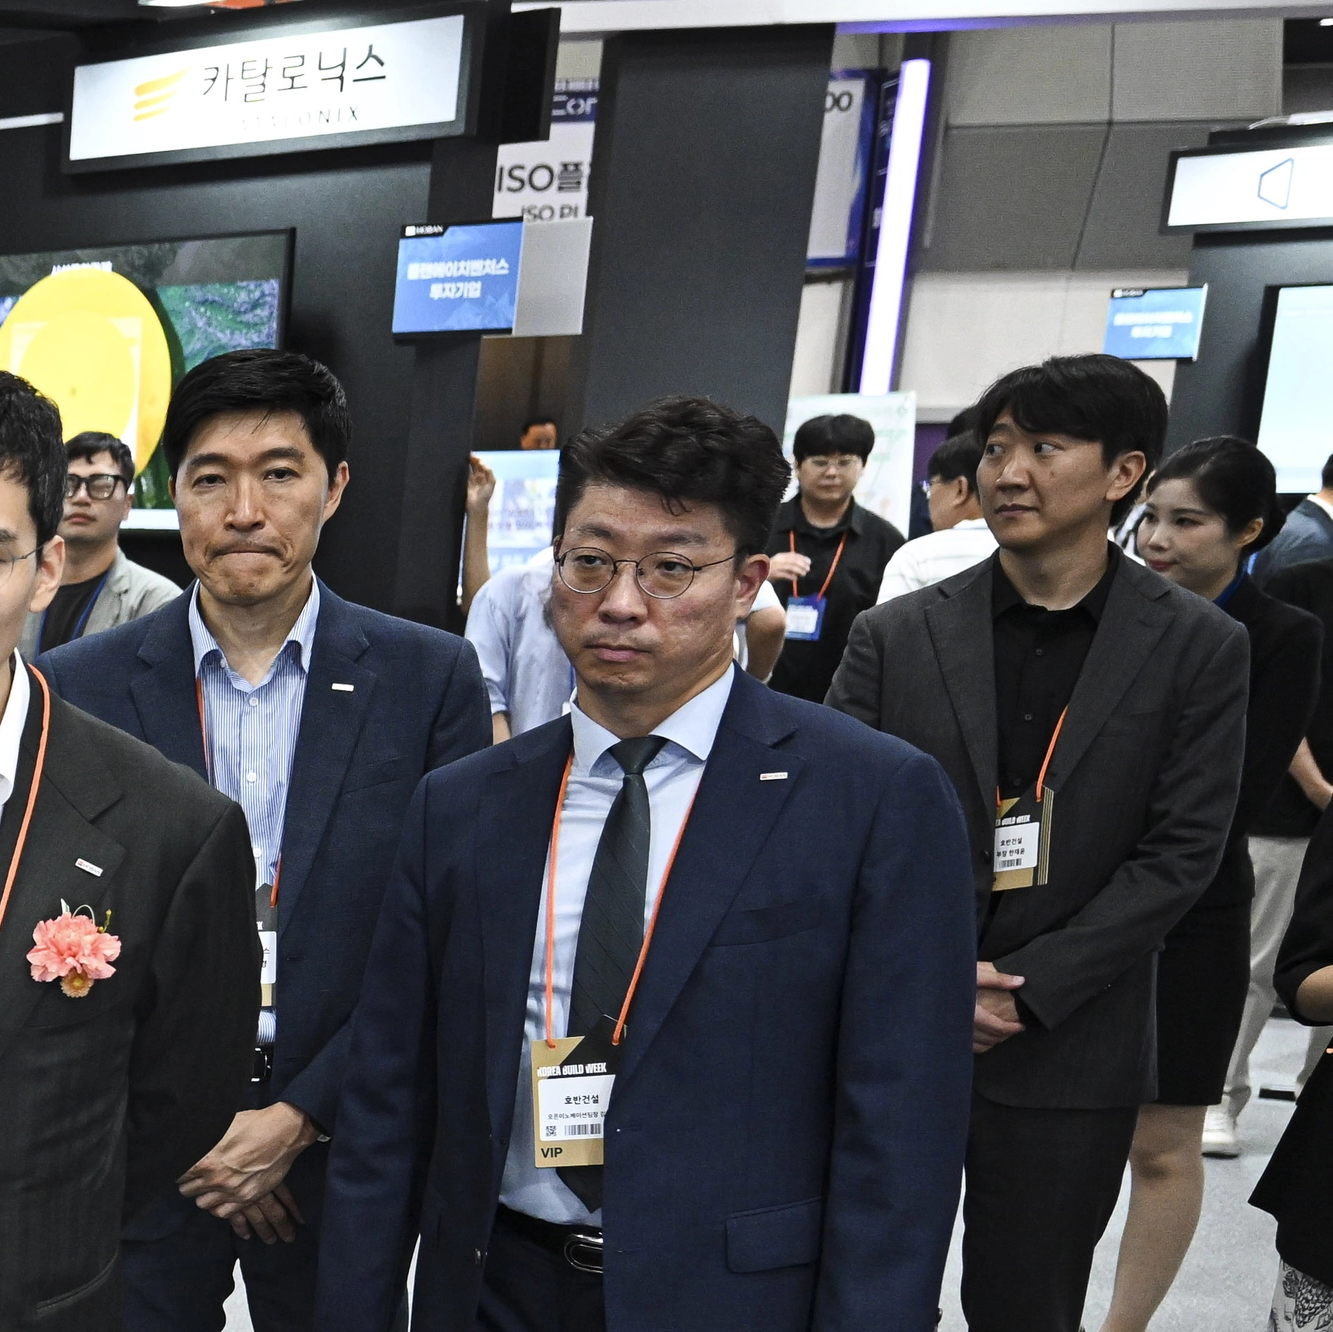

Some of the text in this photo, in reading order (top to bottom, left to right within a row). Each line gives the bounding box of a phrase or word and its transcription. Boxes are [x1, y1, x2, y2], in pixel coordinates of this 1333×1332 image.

[203, 44, 386, 103] 카탈로닉스
[497, 161, 584, 193] ISO플
[537, 1062, 607, 1077] KOREA BUILD WEEK
[564, 1094, 599, 1105] 호반건설
[541, 1147, 563, 1158] VIP
